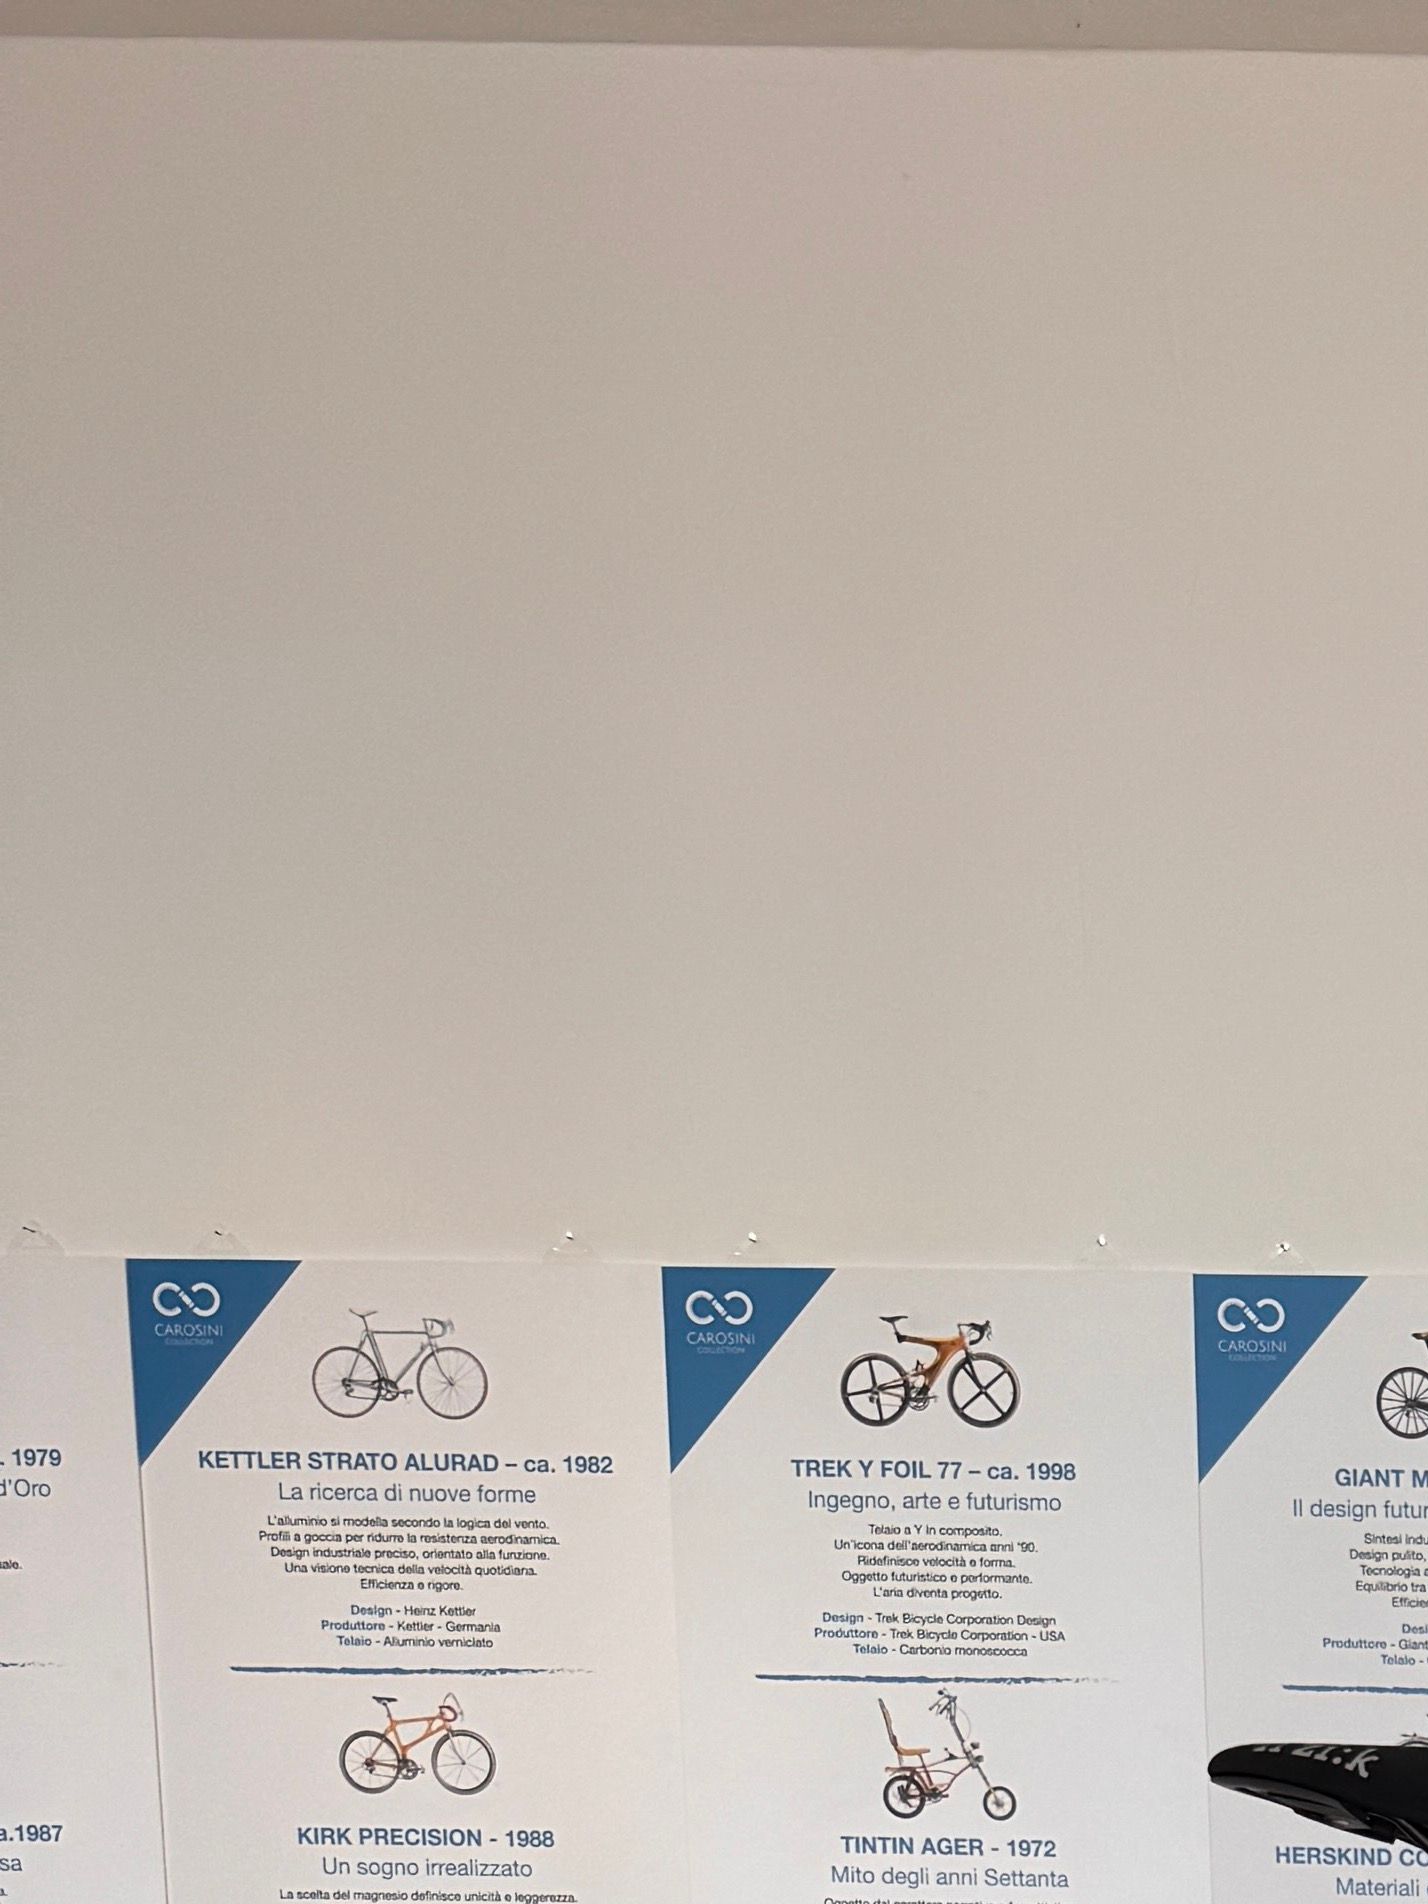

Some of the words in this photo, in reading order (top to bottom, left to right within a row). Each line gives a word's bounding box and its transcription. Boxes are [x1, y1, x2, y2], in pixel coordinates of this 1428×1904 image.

[154, 1323, 223, 1338] CAROSINI
[1217, 1339, 1287, 1354] CAROSINI
[198, 1450, 302, 1470] KETTLER
[307, 1451, 398, 1471] STRATO
[404, 1452, 499, 1472] ALURAD
[523, 1459, 556, 1474] ca.
[562, 1455, 614, 1474] 1982
[790, 1459, 853, 1478] TREK
[858, 1459, 874, 1478] Y
[880, 1460, 932, 1479] FOIL
[937, 1461, 963, 1480] 77
[987, 1466, 1019, 1480] ca.
[1026, 1462, 1077, 1481] 1998
[1334, 1468, 1405, 1488] GIANT
[297, 1827, 353, 1846] KIRK
[358, 1827, 482, 1847] PRECISION
[505, 1829, 555, 1848] 1988
[840, 1835, 914, 1855] TINTIN
[920, 1837, 984, 1857] AGER
[1007, 1839, 1057, 1858] 1972
[322, 1856, 351, 1875] Un
[356, 1861, 420, 1881] sogno
[425, 1858, 533, 1878] irrealizzato
[831, 1865, 875, 1884] Mito
[881, 1866, 930, 1890] degli
[936, 1867, 978, 1886] anni
[984, 1867, 1070, 1888] Settanta
